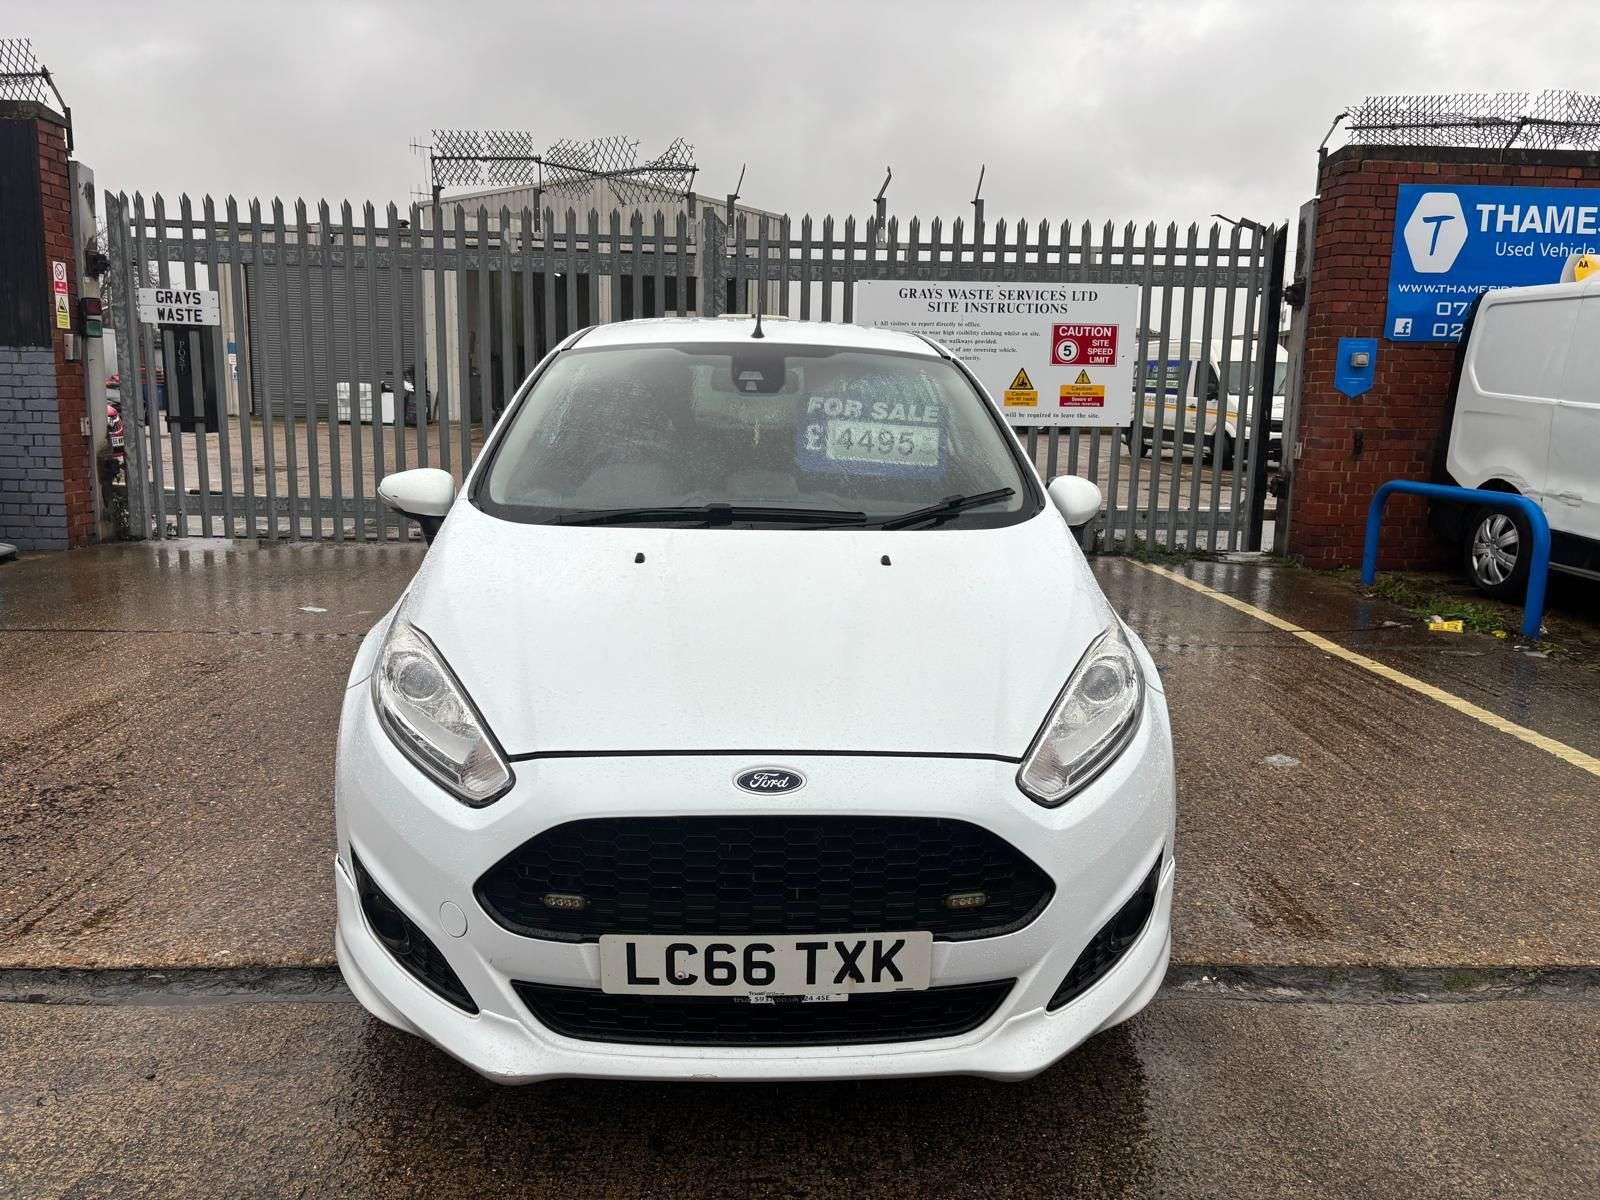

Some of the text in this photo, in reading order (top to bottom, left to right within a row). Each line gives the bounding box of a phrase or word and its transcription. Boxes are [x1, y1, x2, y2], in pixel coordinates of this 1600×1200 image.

[1476, 204, 1600, 235] THAME
[1495, 241, 1534, 257] Used
[1578, 260, 1589, 269] AA
[155, 290, 202, 305] GRAYS
[899, 287, 1098, 302] GRAYS WASTE SERVICES LTD
[157, 308, 203, 322] WASTE
[927, 302, 1068, 314] SITE INSTRUCTIONS
[1436, 302, 1472, 316] 07
[1059, 326, 1112, 337] CAUTION
[1092, 339, 1110, 347] SITE
[1063, 345, 1072, 357] 5
[1087, 347, 1114, 355] SPEED
[1090, 356, 1110, 364] LIMIT
[807, 396, 940, 423] FOR SALE
[838, 427, 915, 456] 4495
[749, 772, 790, 789] Ford
[625, 939, 906, 987] LC66 TXK
